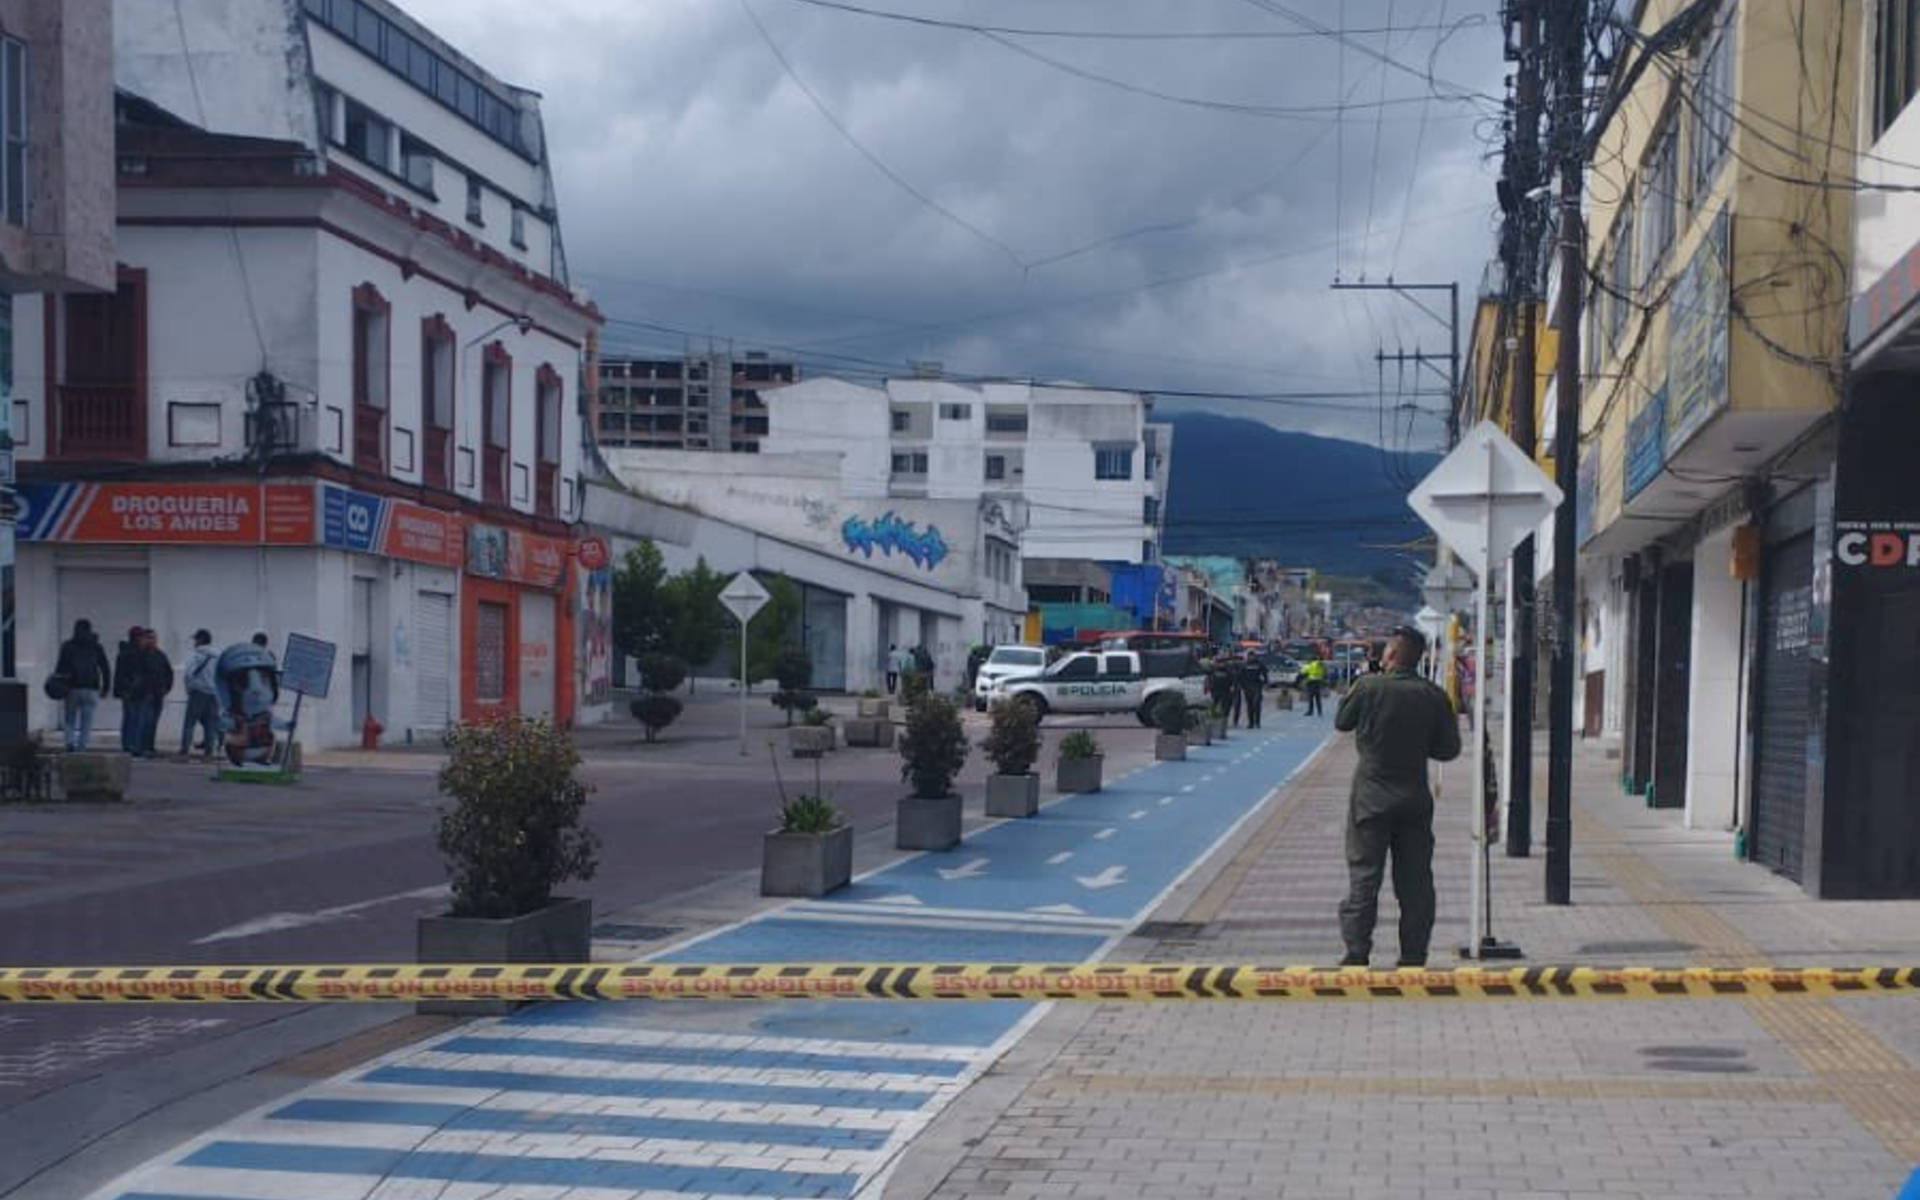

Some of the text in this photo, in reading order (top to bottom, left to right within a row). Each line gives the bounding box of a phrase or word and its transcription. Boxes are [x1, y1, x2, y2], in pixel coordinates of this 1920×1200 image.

[112, 495, 248, 514] DROGUERÍA
[122, 516, 239, 531] LOS ANDES
[84, 979, 122, 994] NO
[622, 978, 855, 993] PELIGRO NO PASE
[933, 974, 1174, 991] PELIGRO NO PASE
[1258, 971, 1325, 988] PASE
[1334, 971, 1374, 987] NO
[388, 980, 423, 994] NO
